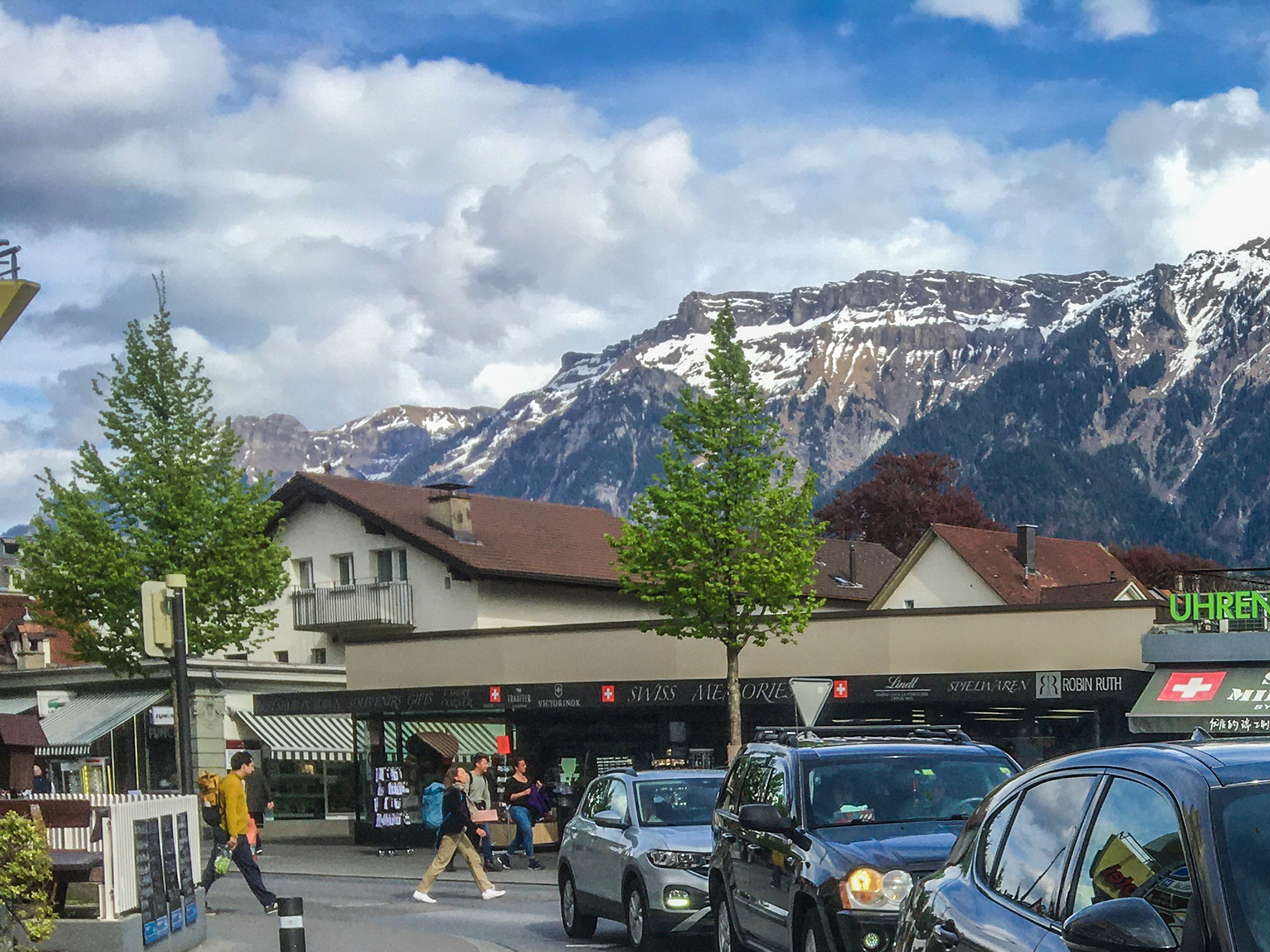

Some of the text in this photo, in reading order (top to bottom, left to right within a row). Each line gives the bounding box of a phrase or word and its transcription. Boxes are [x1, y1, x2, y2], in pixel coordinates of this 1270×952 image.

[885, 676, 919, 689] Lindt
[947, 678, 1031, 692] SPIELWAREN
[1063, 677, 1093, 692] ROBIN
[1095, 676, 1122, 691] RUTH
[627, 685, 678, 702] SWISS
[538, 699, 580, 707] VICTORINOX
